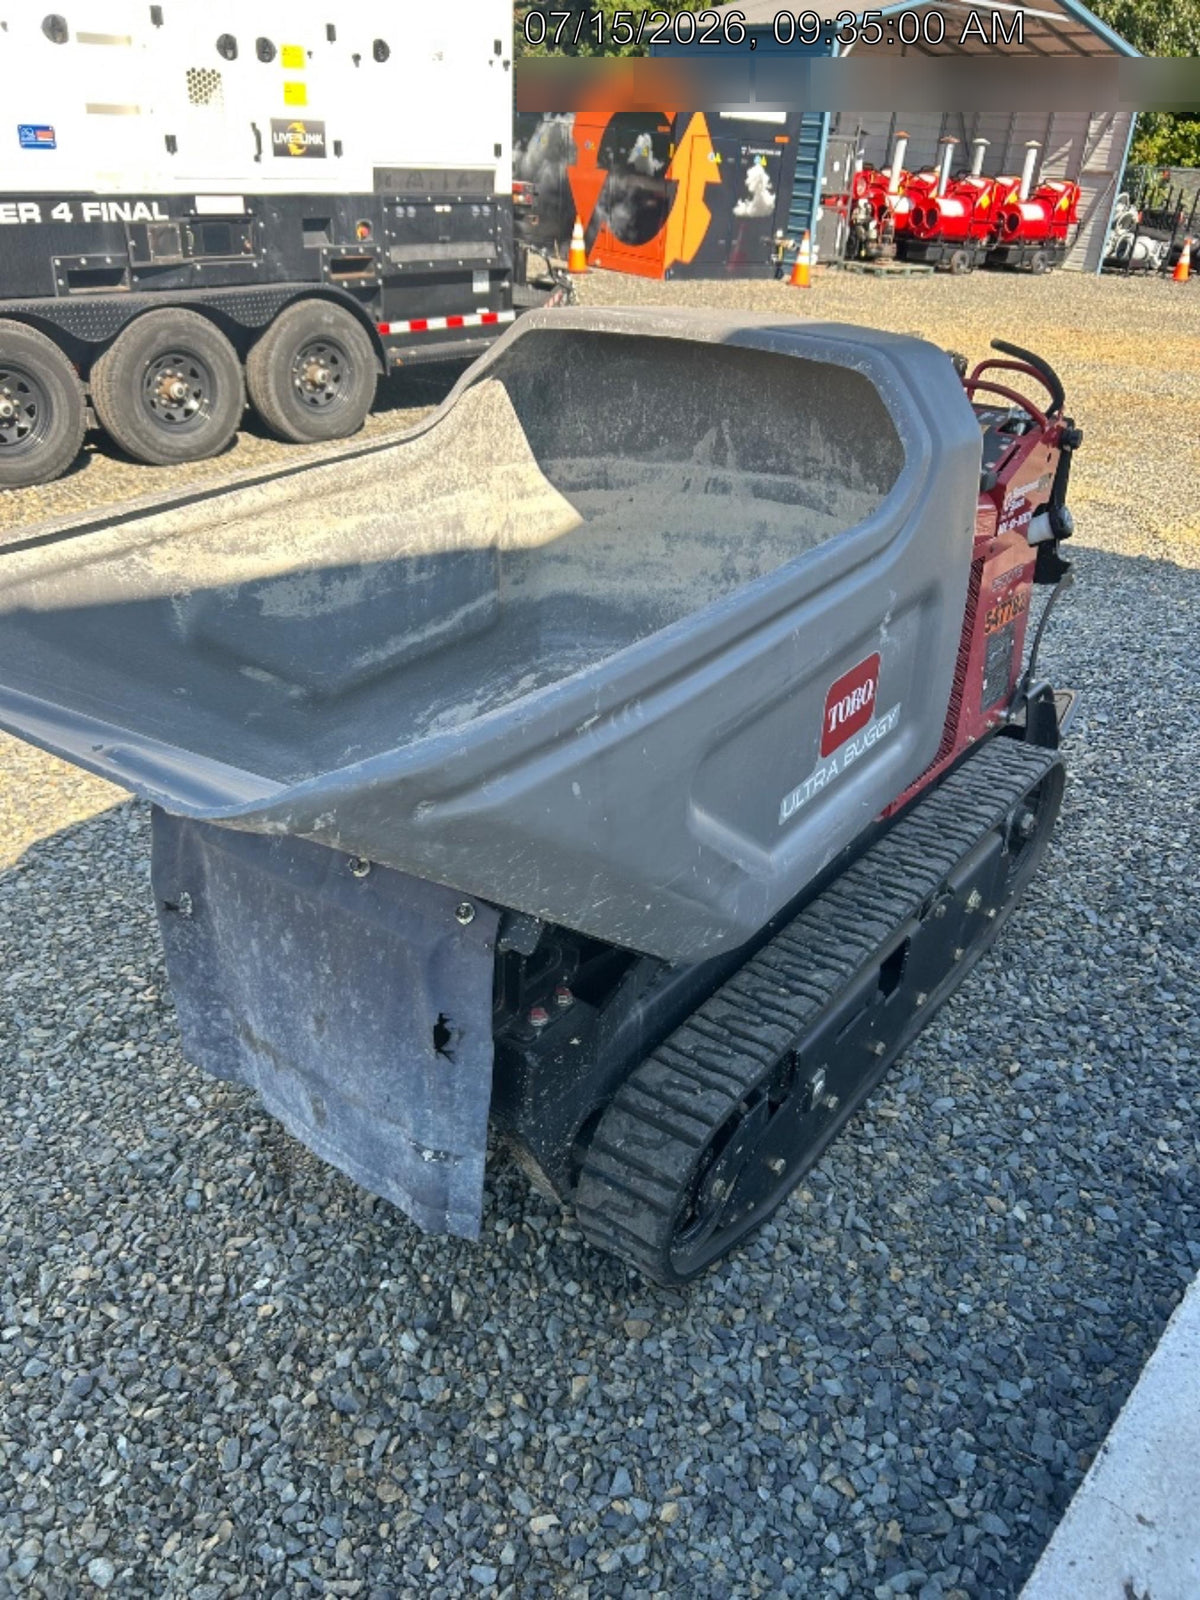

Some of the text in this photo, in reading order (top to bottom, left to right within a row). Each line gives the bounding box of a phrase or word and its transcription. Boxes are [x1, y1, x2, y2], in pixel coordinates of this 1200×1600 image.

[51, 202, 73, 223] 4
[82, 201, 169, 223] FINAL
[828, 678, 874, 733] TORO
[781, 708, 898, 818] ULTRA BUGGY
